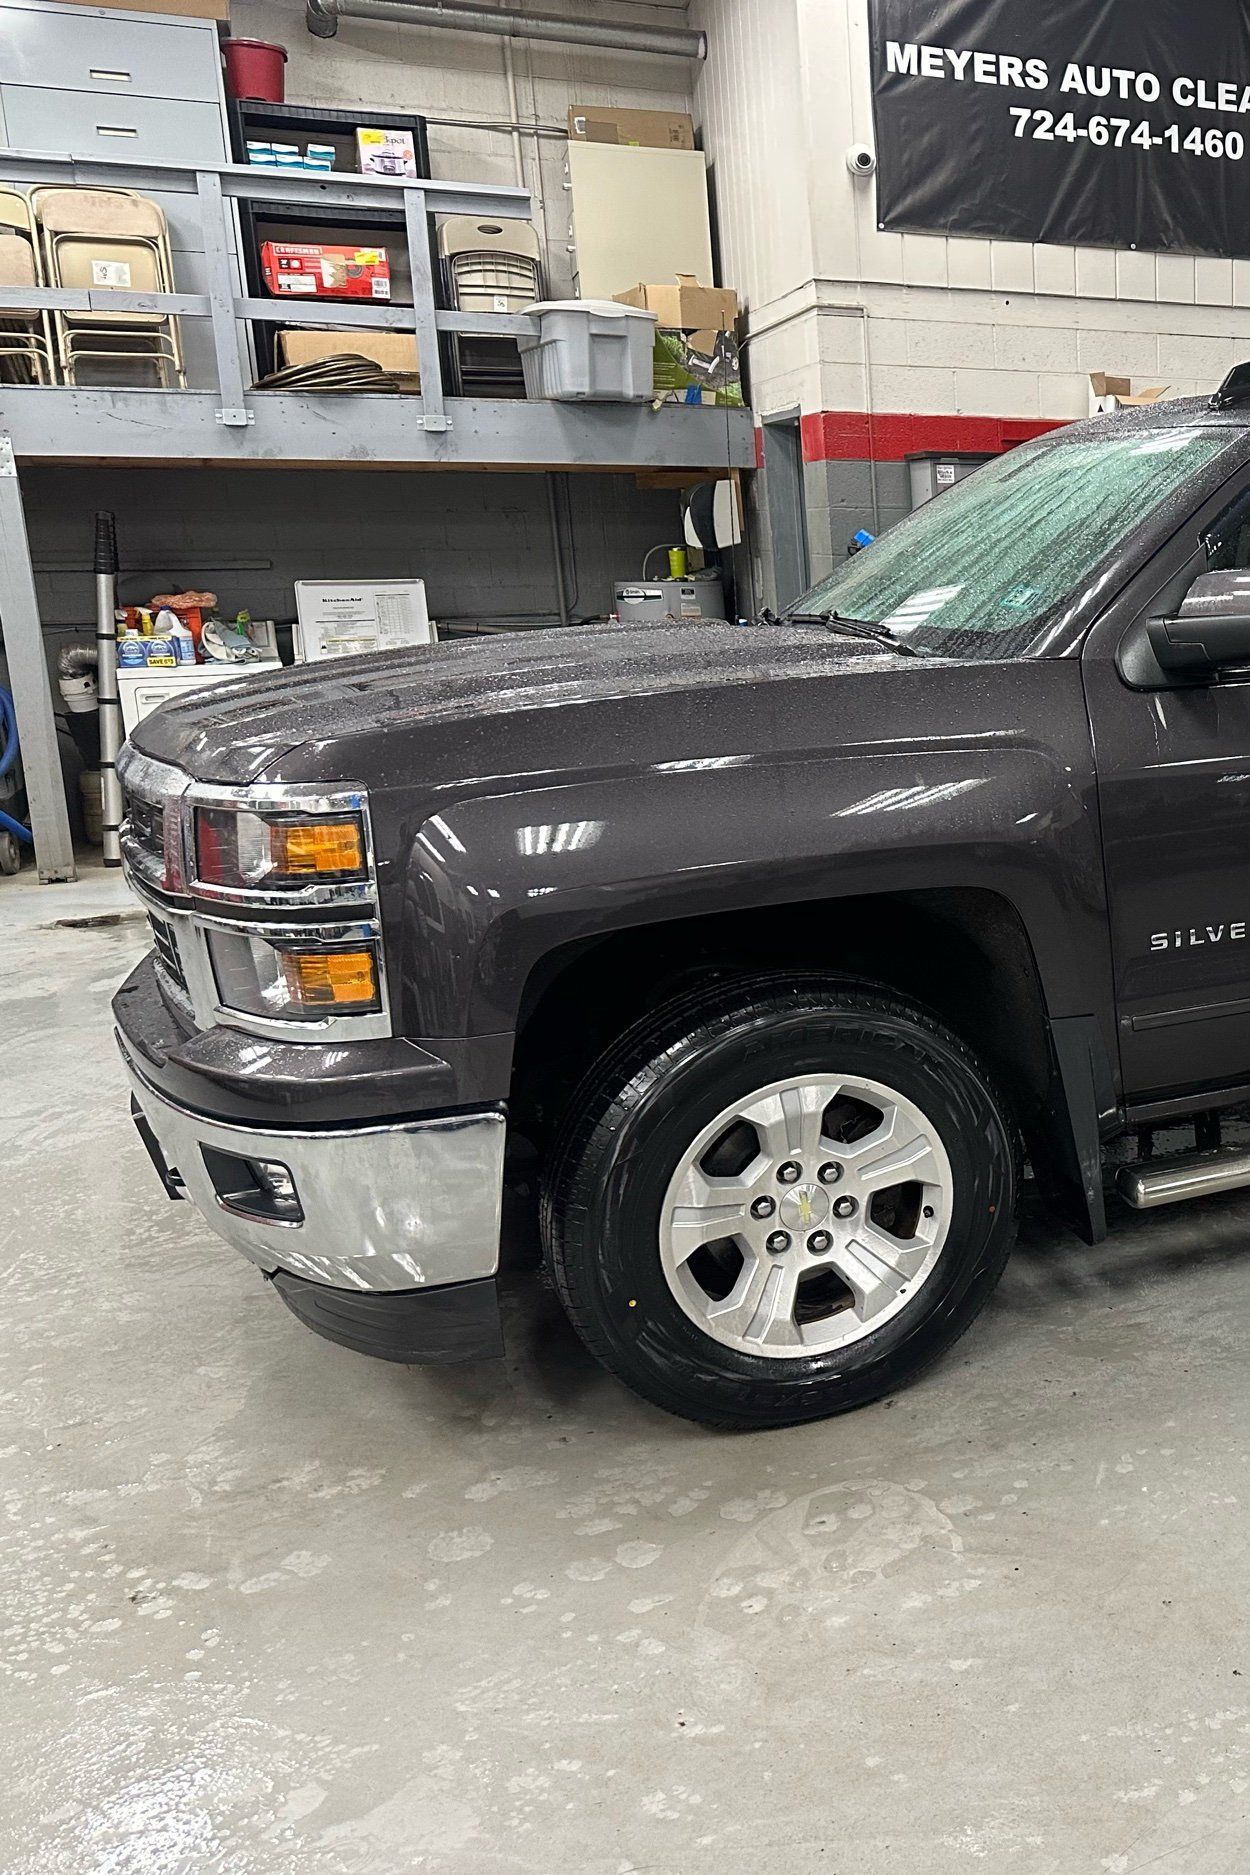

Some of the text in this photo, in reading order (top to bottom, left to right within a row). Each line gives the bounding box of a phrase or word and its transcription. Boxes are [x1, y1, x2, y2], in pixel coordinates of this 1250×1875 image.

[885, 41, 1049, 90] MEYERS
[1060, 63, 1161, 103] AUTO
[1008, 107, 1244, 161] 724-674-1460
